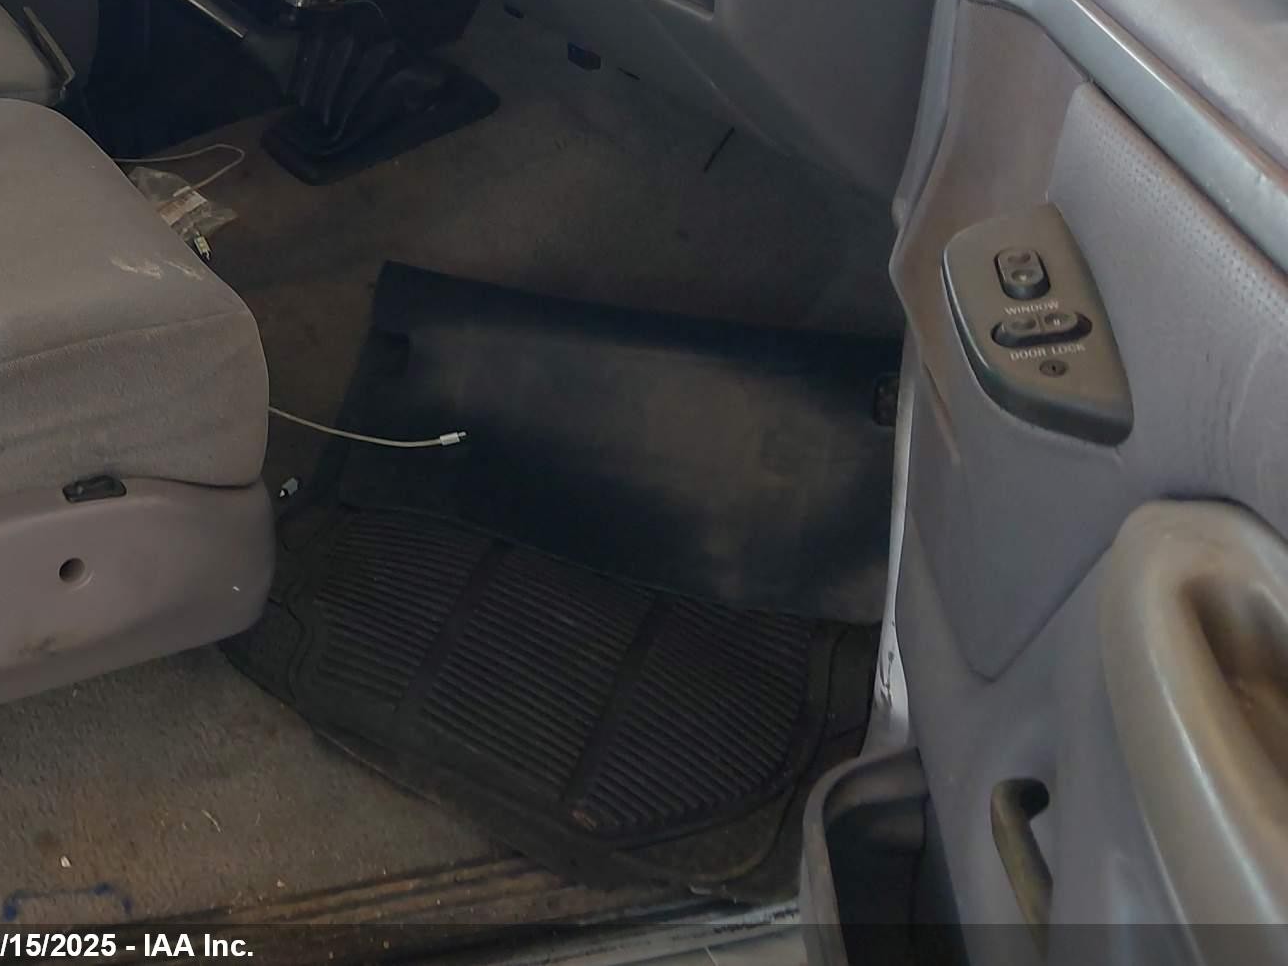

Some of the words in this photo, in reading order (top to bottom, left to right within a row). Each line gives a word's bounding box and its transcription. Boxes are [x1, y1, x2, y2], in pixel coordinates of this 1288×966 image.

[1004, 301, 1059, 315] WINDOW
[1010, 347, 1047, 361] DOOR
[1052, 343, 1086, 355] LOCK
